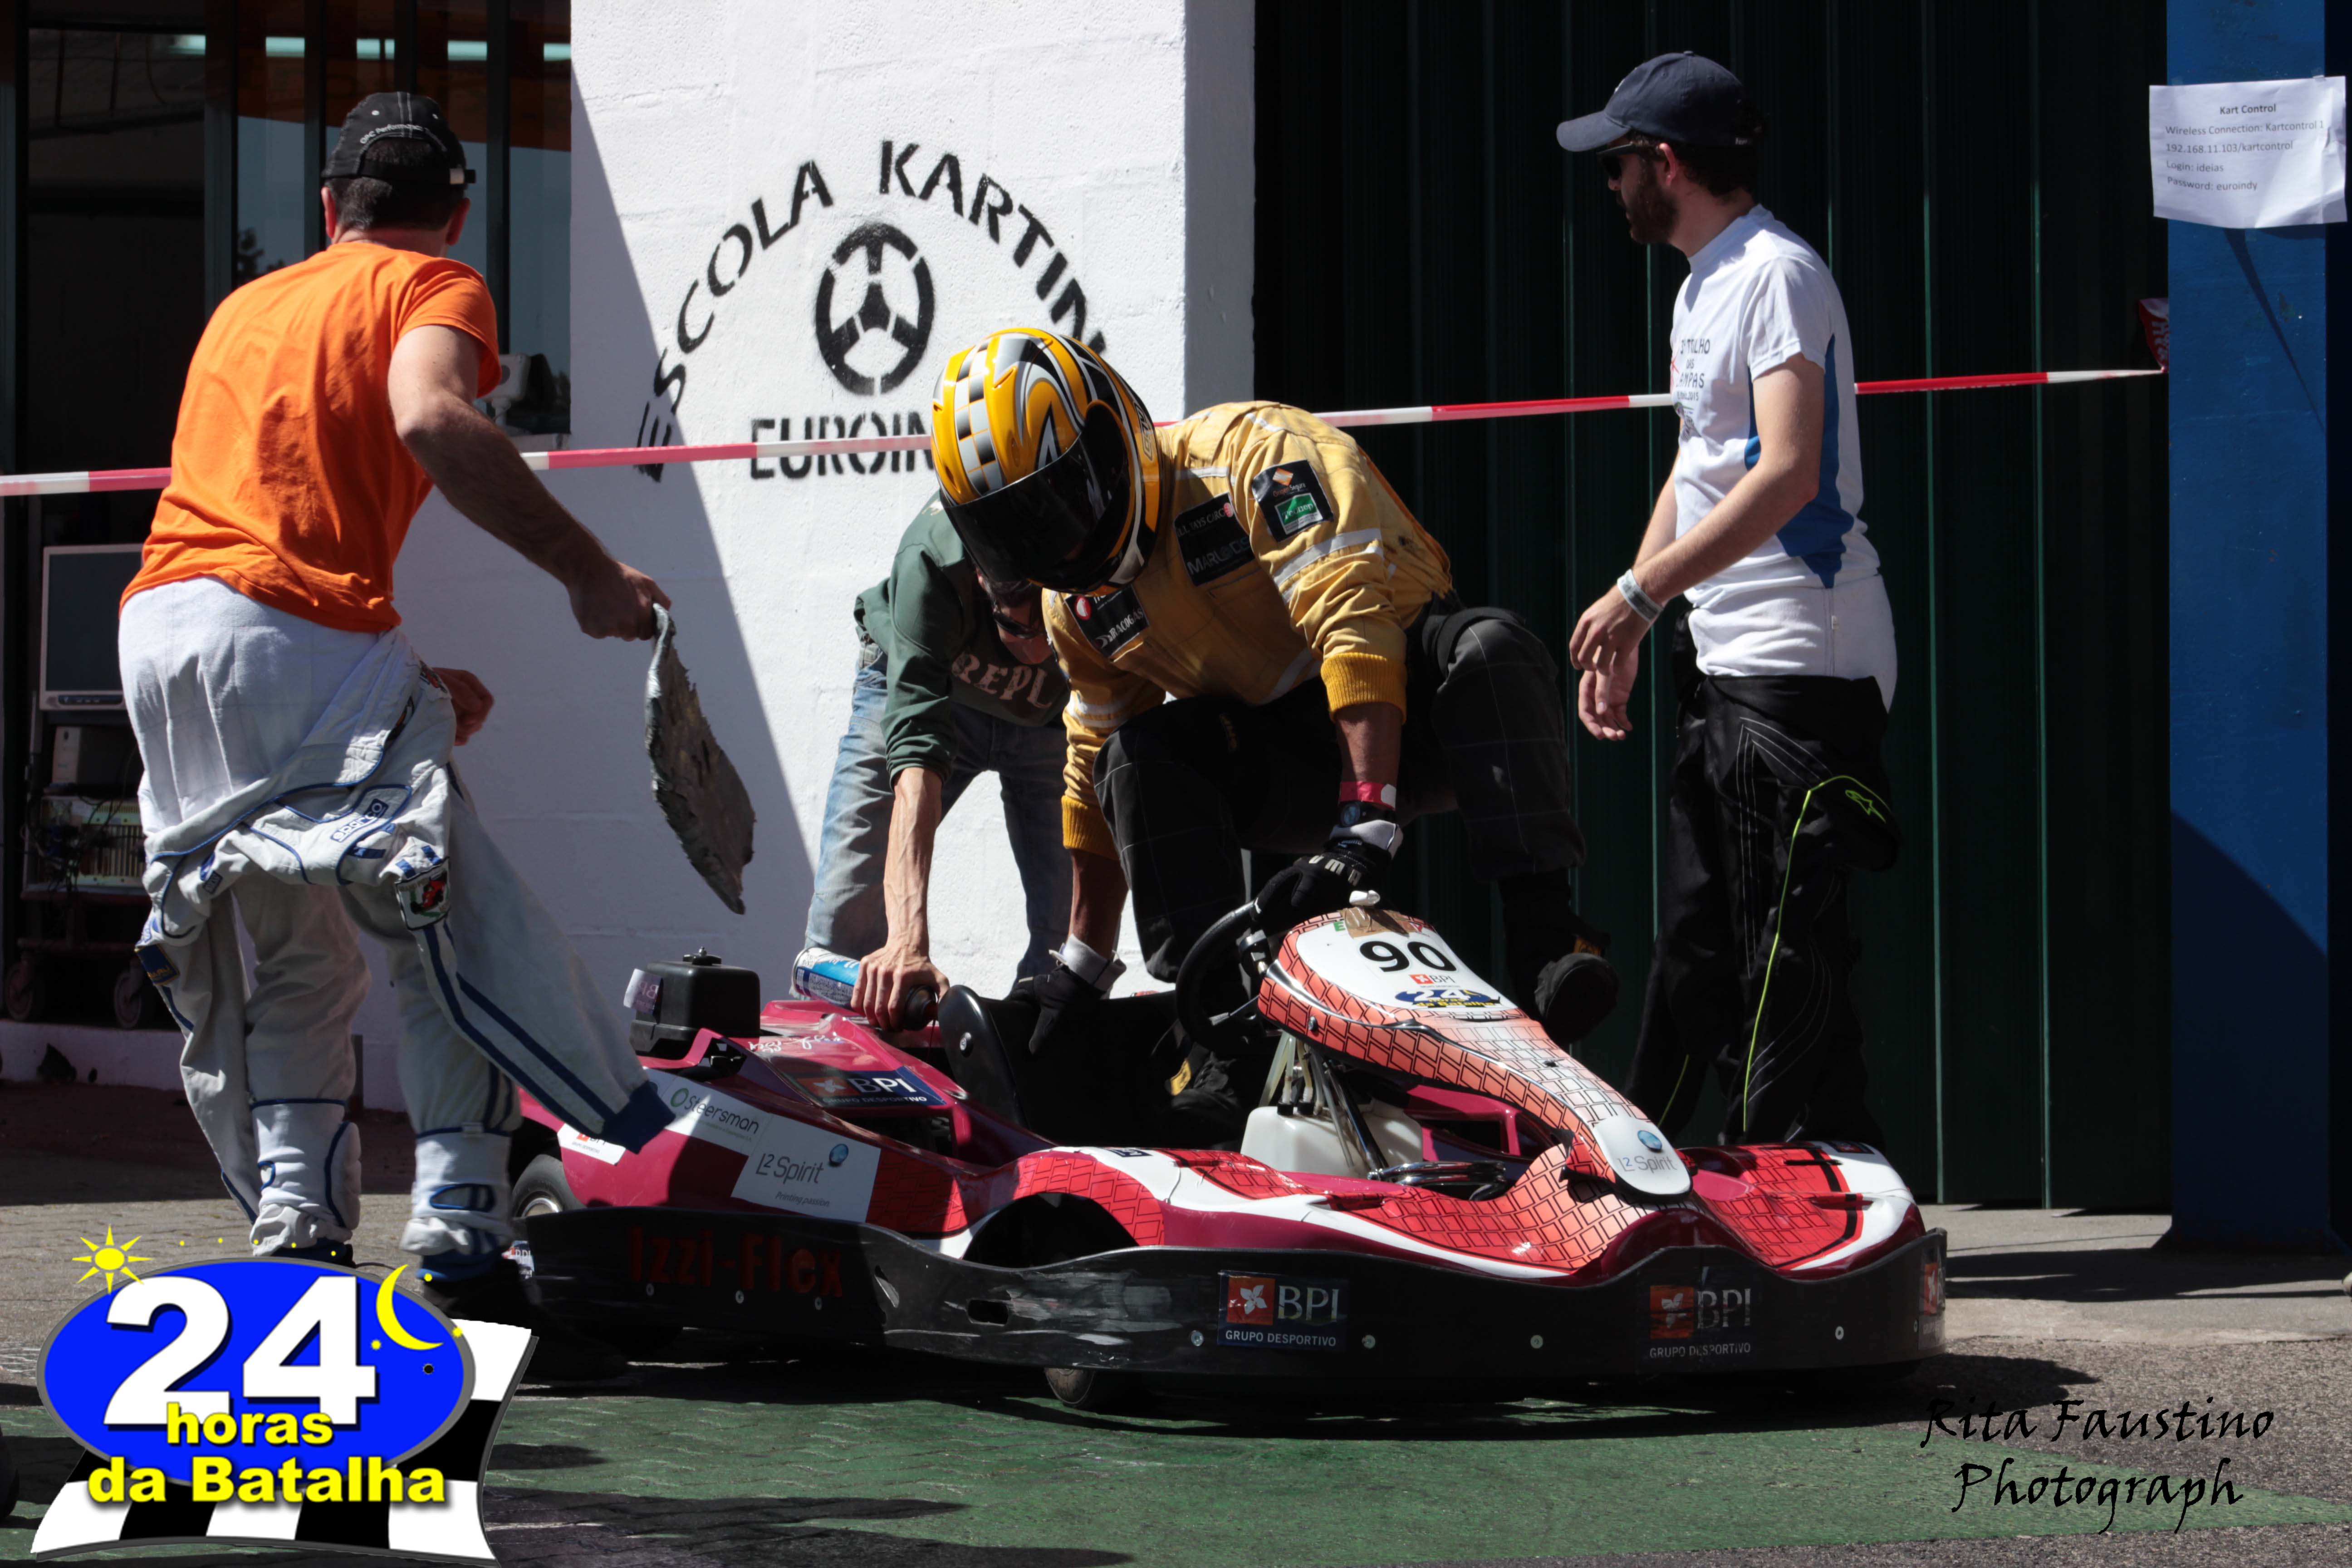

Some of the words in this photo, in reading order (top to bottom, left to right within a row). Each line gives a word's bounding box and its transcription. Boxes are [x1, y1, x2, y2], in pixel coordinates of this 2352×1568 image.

[2220, 106, 2239, 115] Kart
[2241, 104, 2276, 114] Control
[2165, 126, 2206, 136] Wireless
[2208, 124, 2263, 135] Connection:
[2266, 120, 2317, 131] Kartcontrol
[2319, 120, 2324, 129] 1
[2166, 141, 2293, 154] 192.168.11.103/kartcontrol
[2166, 161, 2194, 172] Login:
[2196, 162, 2224, 172] ideias
[2167, 176, 2213, 191] Password:
[2216, 180, 2258, 191] euroindy
[634, 160, 835, 483] ESCOLA
[878, 140, 1106, 355] KARTIN
[1676, 372, 1705, 389] AMPAS
[750, 411, 934, 480] EUROIN
[1359, 941, 1457, 972] 90
[1407, 990, 1471, 1002] 24
[847, 1077, 916, 1093] BPI
[684, 1095, 760, 1134] Steersman
[773, 1156, 824, 1185] Spirit
[1634, 1155, 1678, 1174] Spirit
[775, 1191, 802, 1207] Printing
[802, 1196, 830, 1208] passion
[1277, 1284, 1341, 1322] BPI
[1695, 1288, 1752, 1329] BPI
[1225, 1330, 1264, 1342] GRUPO
[1267, 1333, 1336, 1347] DESPORTIVO
[1649, 1346, 1686, 1358] GRUPO
[1689, 1343, 1751, 1357] DESPORTIVO
